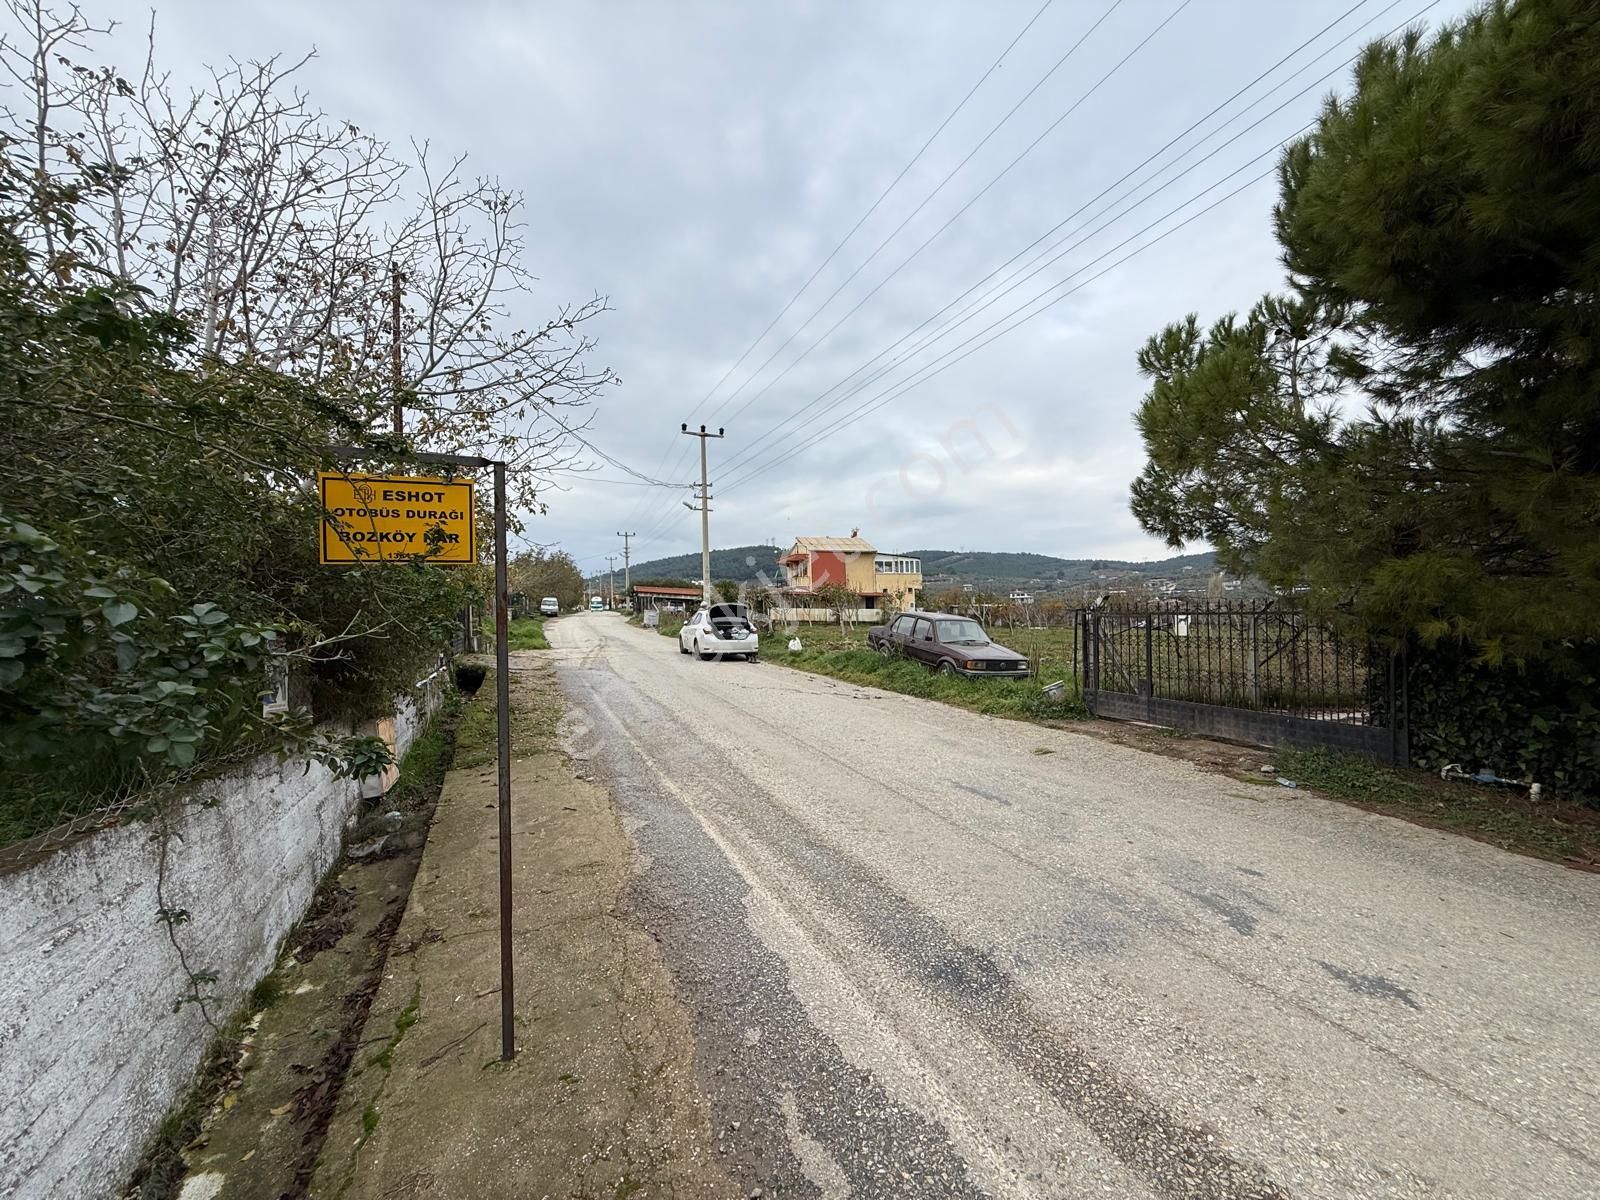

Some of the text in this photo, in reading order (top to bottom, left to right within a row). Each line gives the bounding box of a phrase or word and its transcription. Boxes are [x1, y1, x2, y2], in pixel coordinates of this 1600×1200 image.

[382, 490, 445, 503] ESHOT
[334, 507, 464, 520] OTOBÜS DURAĞI
[339, 530, 417, 543] BOZKÖY
